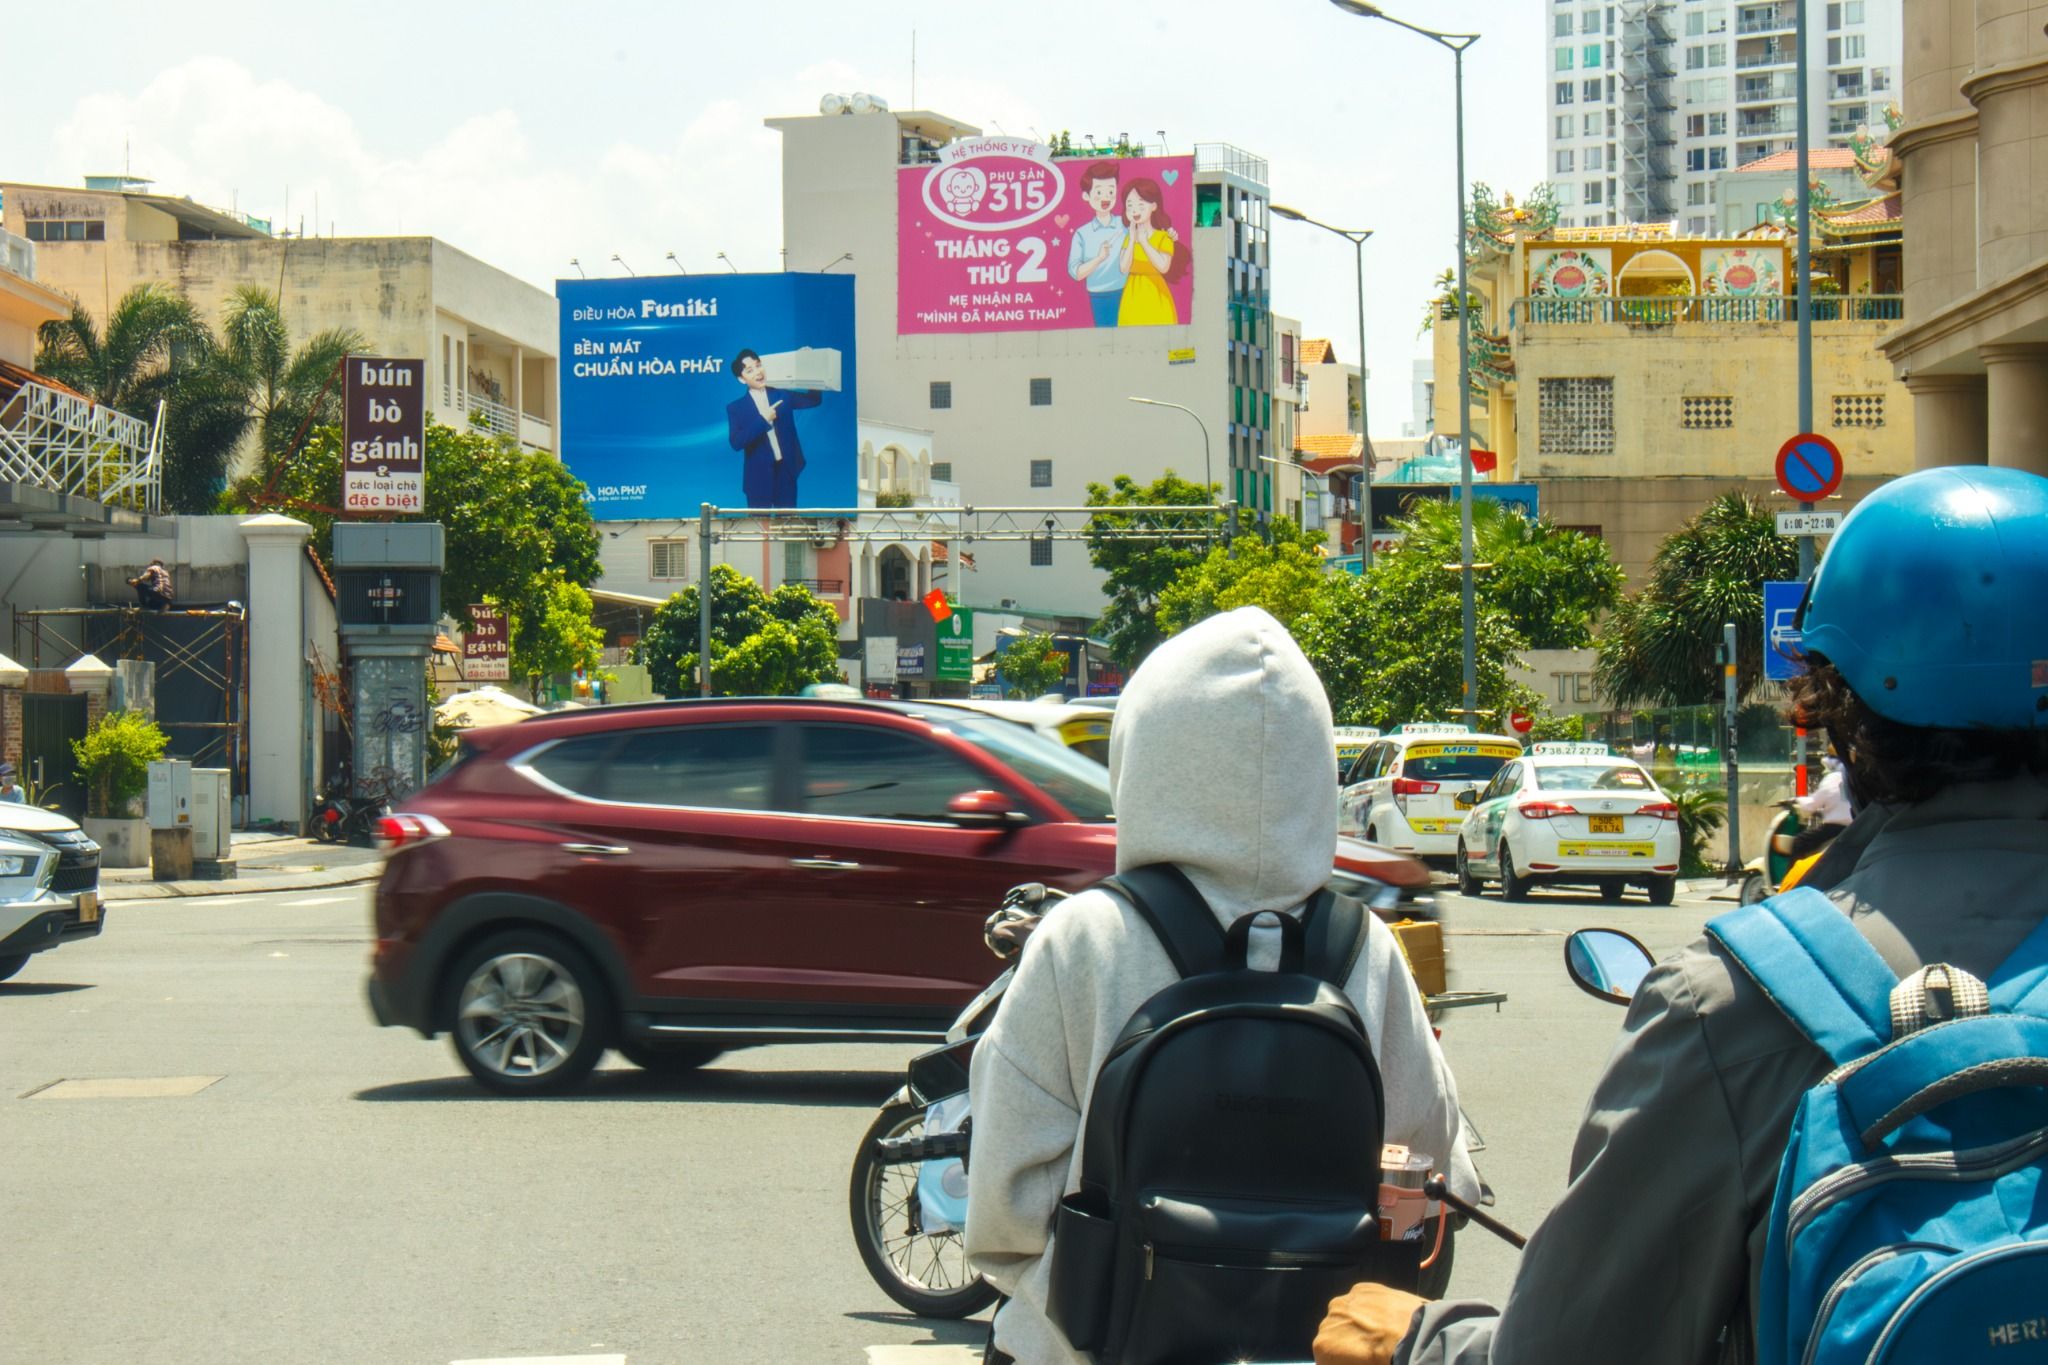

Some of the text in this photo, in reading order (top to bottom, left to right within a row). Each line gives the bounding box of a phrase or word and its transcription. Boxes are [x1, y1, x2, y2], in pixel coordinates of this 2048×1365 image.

[951, 138, 1037, 160] HỆ THỐNG Y TẾ
[989, 167, 1045, 183] PHỤ SẢN
[988, 180, 1046, 212] 315
[935, 235, 1010, 259] THÁNG
[1016, 236, 1048, 283] 2
[967, 261, 1012, 285] THỨ
[573, 298, 717, 321] ĐIỀU HÒA Funiki
[949, 291, 1034, 308] MẸ NHẬN RA
[961, 309, 981, 323] ĐÃ
[985, 310, 1024, 323] MANG
[573, 337, 641, 356] BỀN MÁT
[361, 361, 412, 387] bún
[573, 355, 723, 378] CHUẨN HÒA PHÁT
[368, 398, 402, 424] bò
[350, 435, 418, 464] gánh
[376, 464, 391, 478] &
[350, 479, 417, 492] các loại chè
[348, 493, 418, 509] đặc biệt
[476, 623, 497, 636] bò
[1442, 746, 1478, 754] MPE
